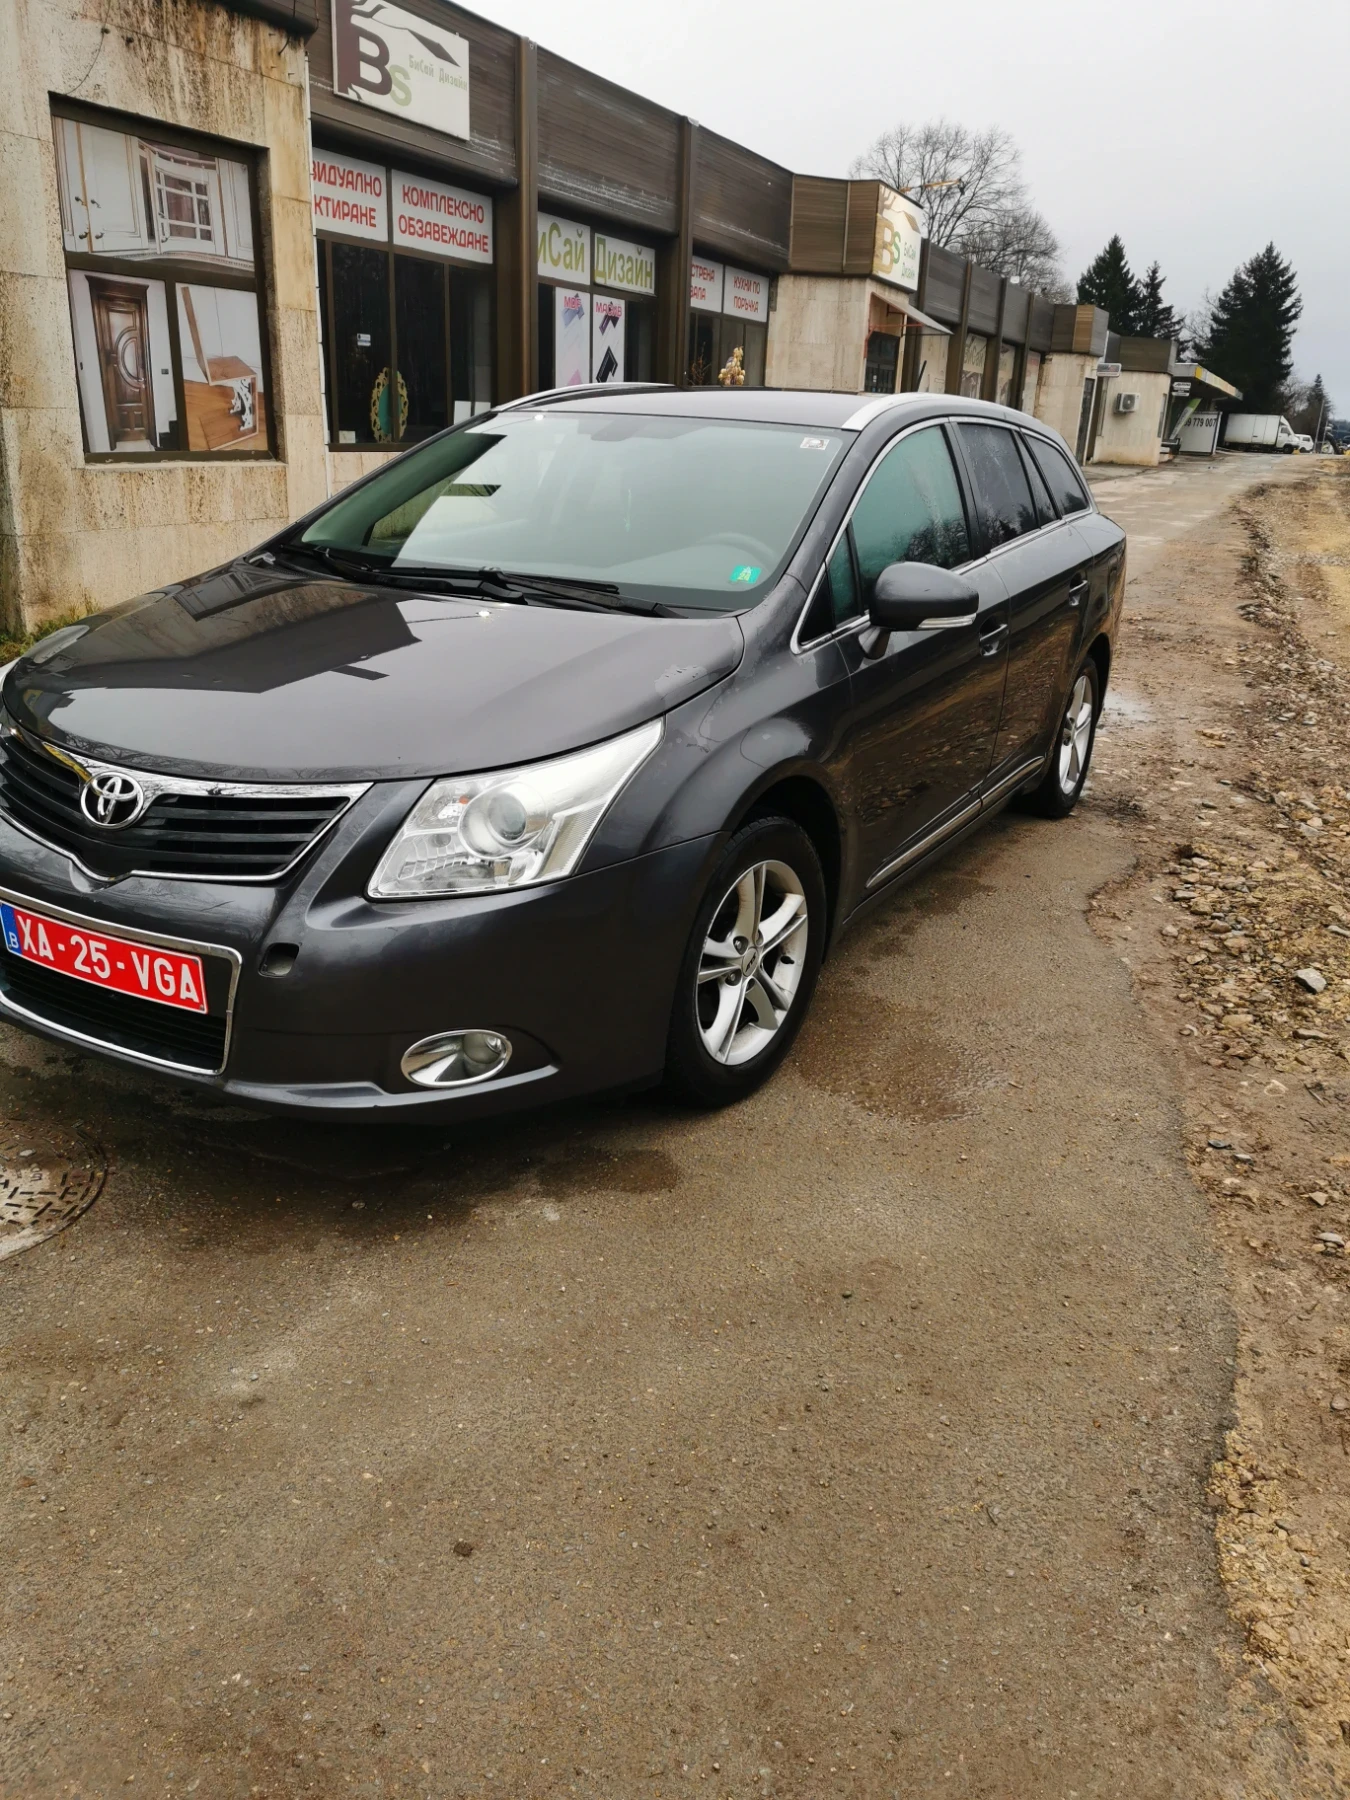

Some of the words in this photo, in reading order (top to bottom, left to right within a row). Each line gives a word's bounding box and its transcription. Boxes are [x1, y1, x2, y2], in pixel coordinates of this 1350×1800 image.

[409, 54, 434, 78] БиСай
[439, 67, 468, 92] Дизайн
[313, 160, 382, 198] ВИДУАЛНО
[314, 193, 377, 228] КТИРАНЕ
[402, 184, 485, 224] КОМПЛЕКСНО
[398, 214, 489, 254] ОБЗАВЕЖДАНЕ
[538, 221, 585, 273] иСай
[595, 236, 653, 290] Дизайн
[691, 263, 715, 283] СТРЕНА
[733, 295, 759, 314] ПОРЪЧКА
[9, 931, 20, 950] B
[17, 914, 201, 1004] XA-25-VGA
